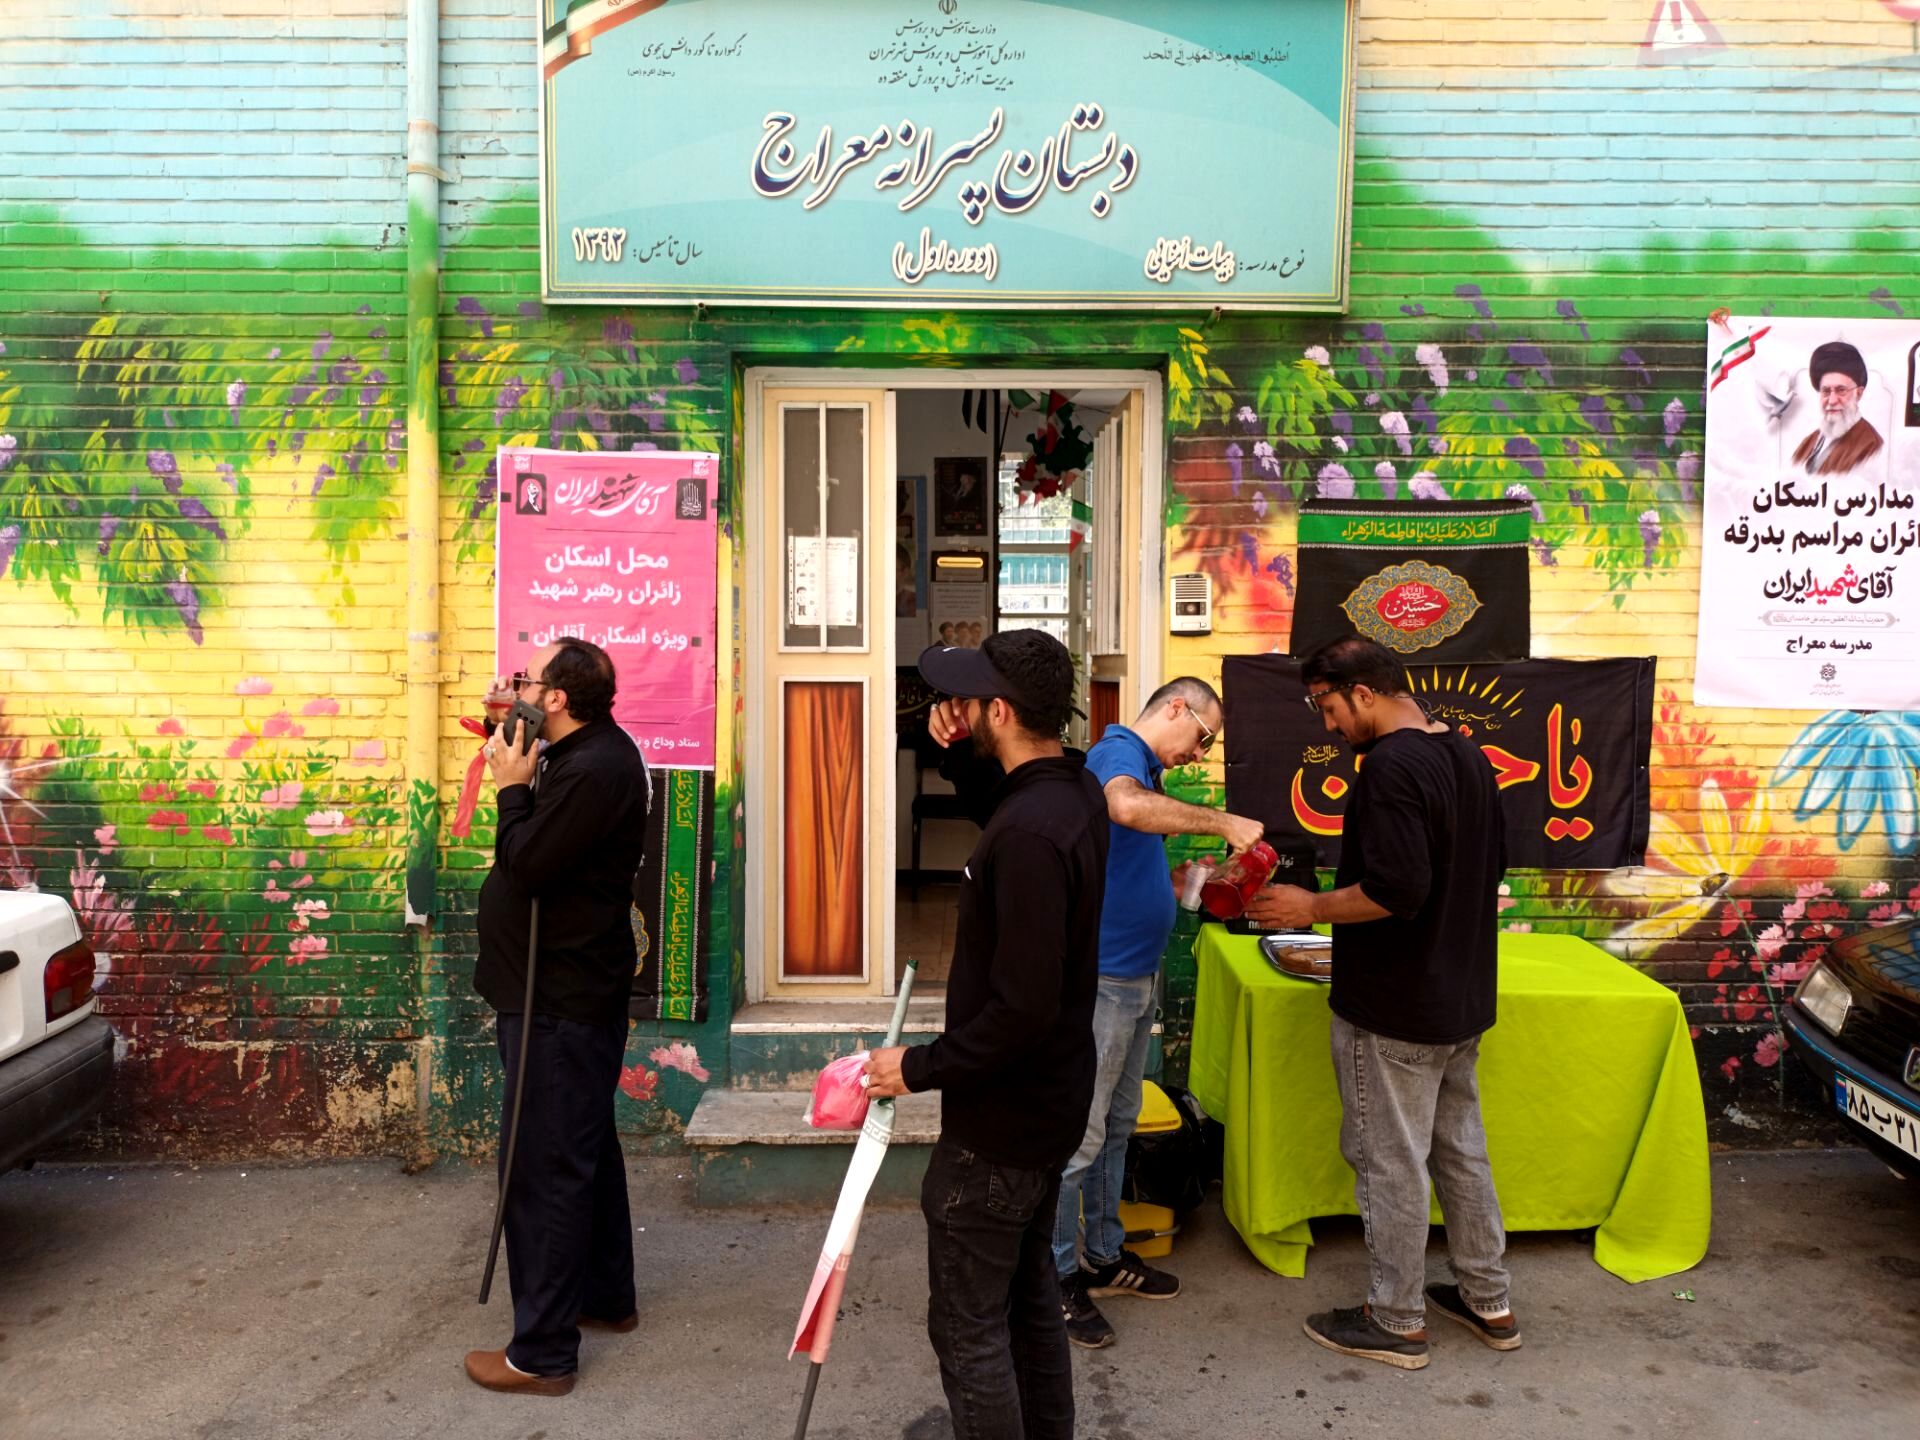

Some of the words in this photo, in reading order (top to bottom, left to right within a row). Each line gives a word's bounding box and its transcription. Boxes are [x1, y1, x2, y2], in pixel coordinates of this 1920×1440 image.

[896, 19, 929, 39] پرورش
[934, 18, 970, 36] آموزش
[968, 24, 996, 34] وزارت
[662, 37, 691, 59] دانش
[693, 32, 714, 56] گور
[707, 44, 715, 56] تا
[904, 42, 942, 66] پرورش
[950, 41, 992, 63] آموزش
[991, 41, 1008, 64] کل
[1003, 50, 1025, 60] اداره
[908, 65, 939, 92] پرورش
[946, 67, 983, 88] آموزش
[981, 73, 1013, 91] مدیریت
[751, 111, 891, 209] معراج
[876, 107, 1004, 225] پسرانه
[994, 103, 1137, 217] دبستان
[676, 241, 702, 265] سال
[1279, 249, 1305, 278] نوع
[554, 476, 599, 516] ایران
[588, 473, 641, 509] شهید
[588, 480, 671, 517] آقای
[1753, 481, 1827, 513] اسکان
[1833, 482, 1914, 517] مدارس
[1724, 515, 1785, 553] بدرقه
[1792, 520, 1863, 555] مراسم
[545, 545, 611, 573] اسکان
[616, 547, 669, 574] محل
[528, 578, 578, 602] شهید
[582, 582, 623, 604] رهبر
[627, 580, 681, 605] زائران
[1763, 567, 1812, 604] ایران
[1803, 563, 1859, 605] شهید
[1846, 565, 1897, 604] آقای
[1384, 597, 1441, 618] حسین
[591, 626, 646, 648] اسکان
[652, 629, 688, 652] ویژه
[1786, 635, 1826, 654] معراج
[1830, 638, 1873, 655] مدرسه
[644, 739, 650, 748] و
[652, 737, 675, 750] وداع
[678, 737, 700, 748] ستاد
[1543, 702, 1594, 842] یا
